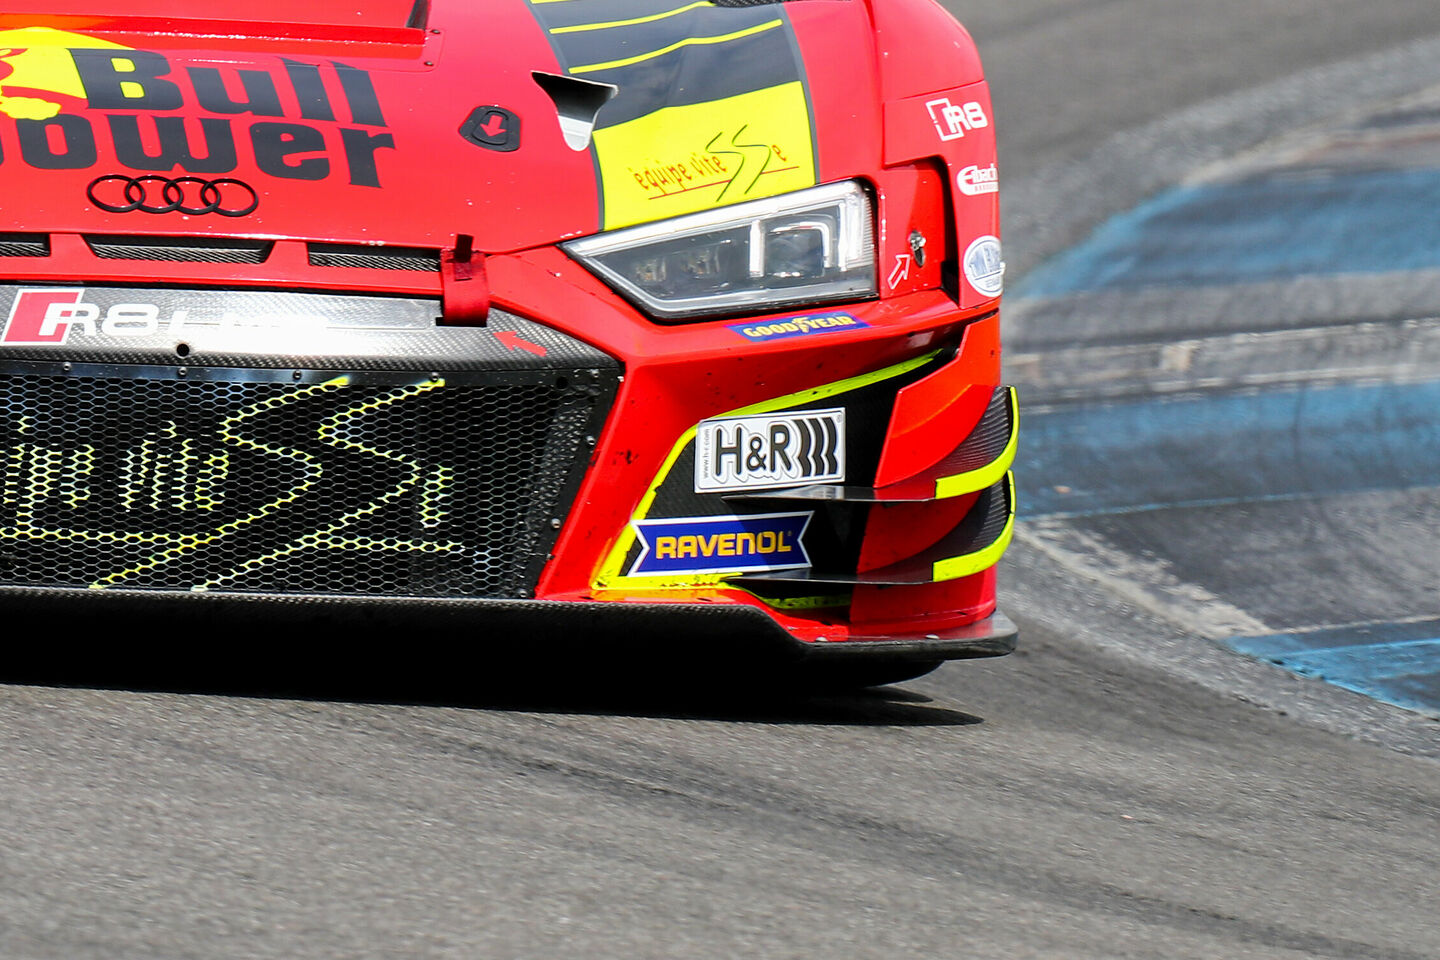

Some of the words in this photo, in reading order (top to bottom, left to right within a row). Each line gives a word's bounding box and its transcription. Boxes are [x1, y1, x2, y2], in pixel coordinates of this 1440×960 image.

[67, 48, 389, 127] Bull
[942, 102, 988, 134] R8
[38, 302, 161, 337] R8
[744, 312, 857, 339] GOODYEAR
[715, 424, 792, 477] H&R
[656, 531, 792, 559] RAVENOL
